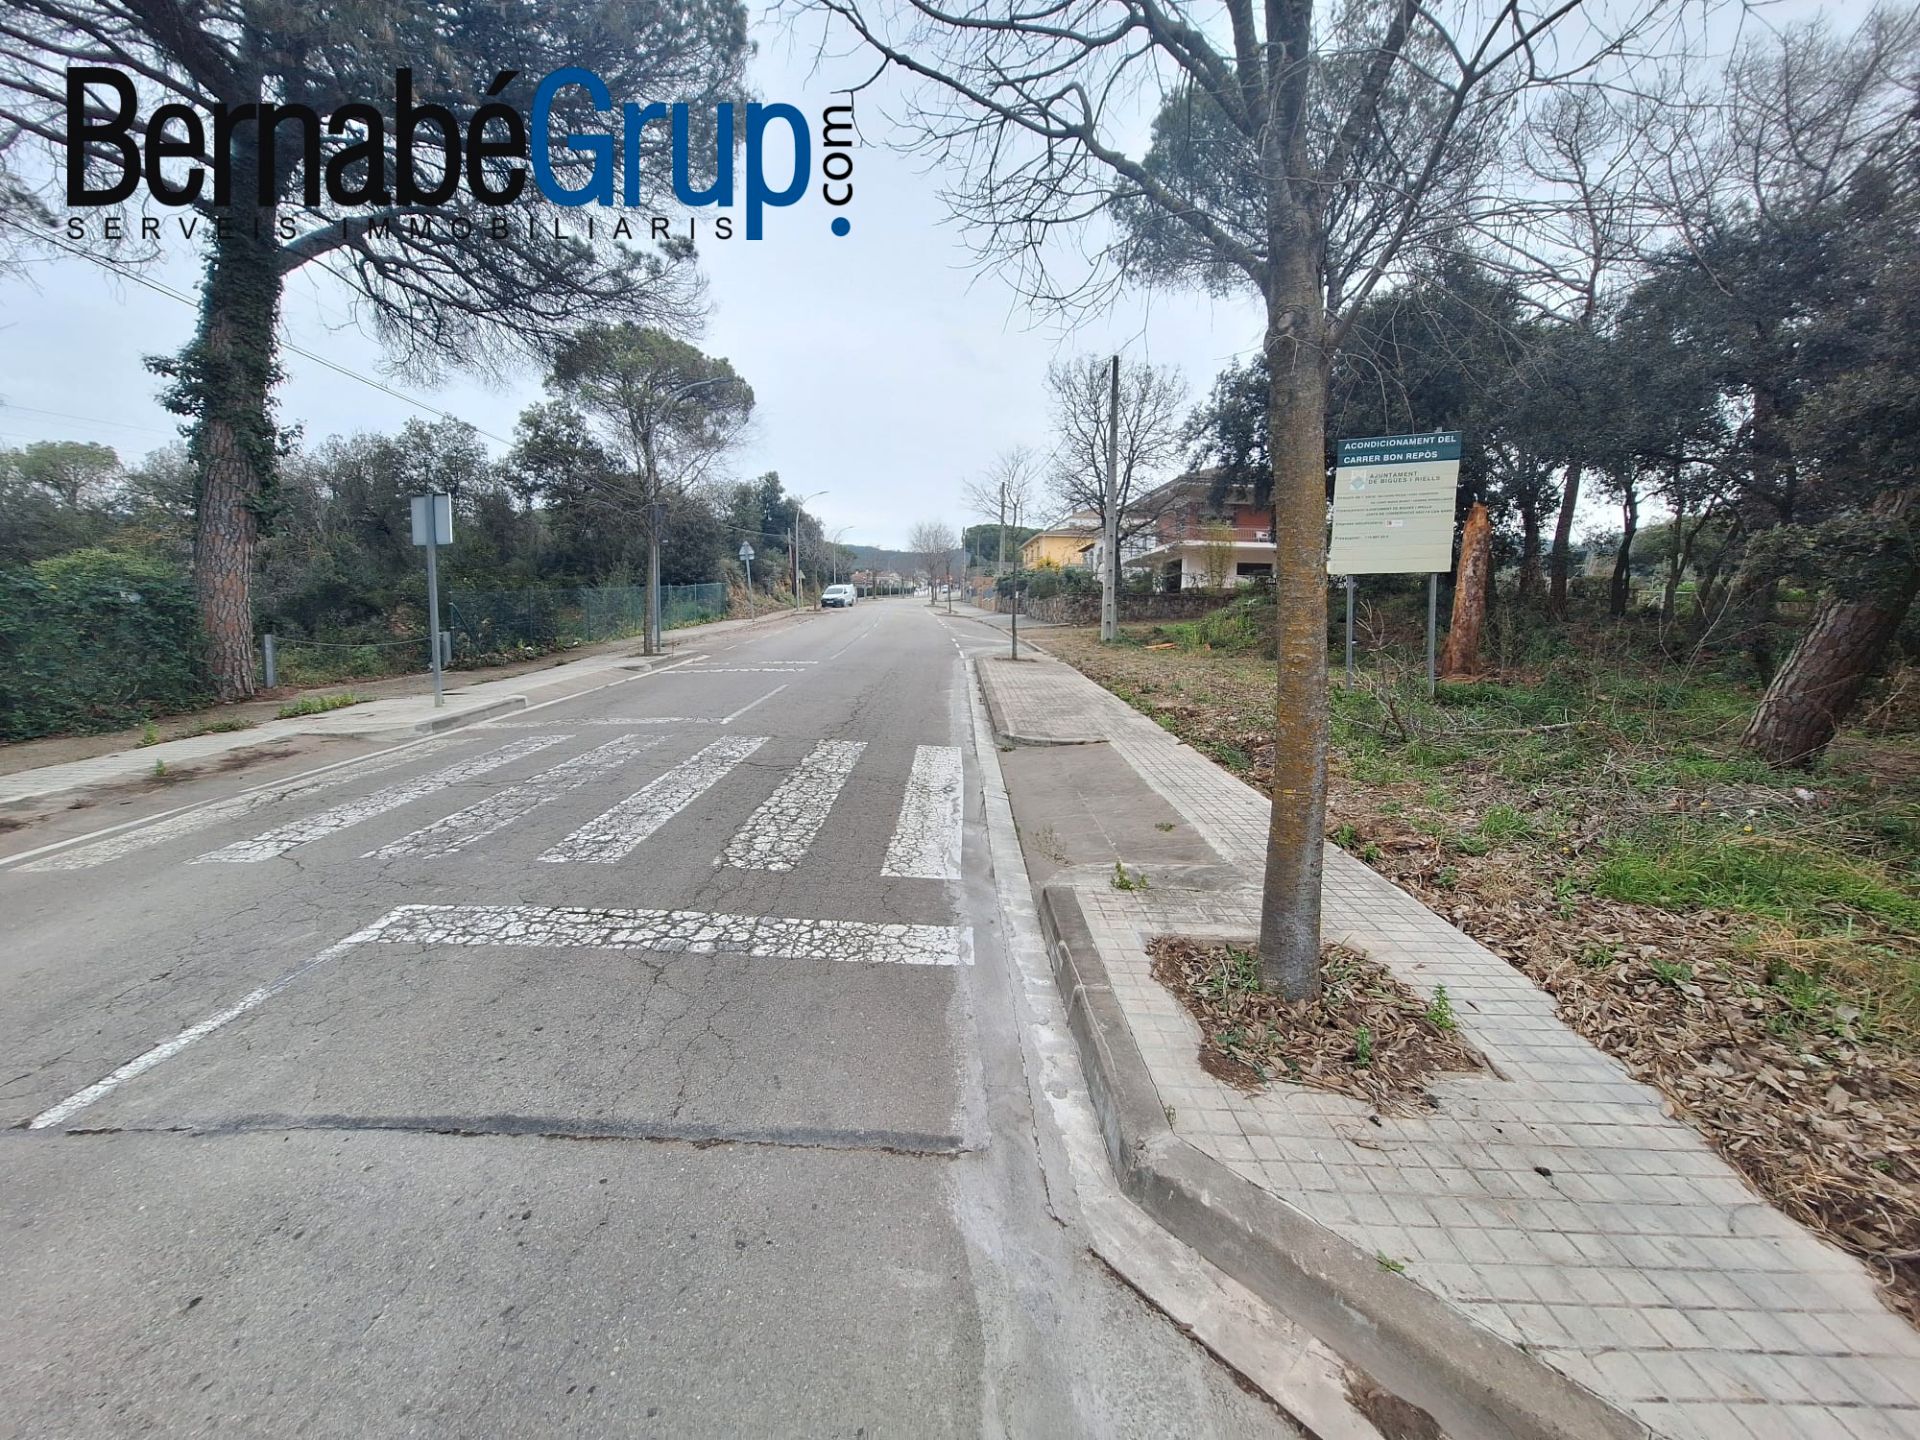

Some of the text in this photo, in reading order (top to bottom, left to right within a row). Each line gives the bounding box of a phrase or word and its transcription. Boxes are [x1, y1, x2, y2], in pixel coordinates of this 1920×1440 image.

[1344, 435, 1457, 450] ACONDICIONAMENT DEL
[1343, 454, 1381, 464] CARRER
[1383, 453, 1403, 461] BON
